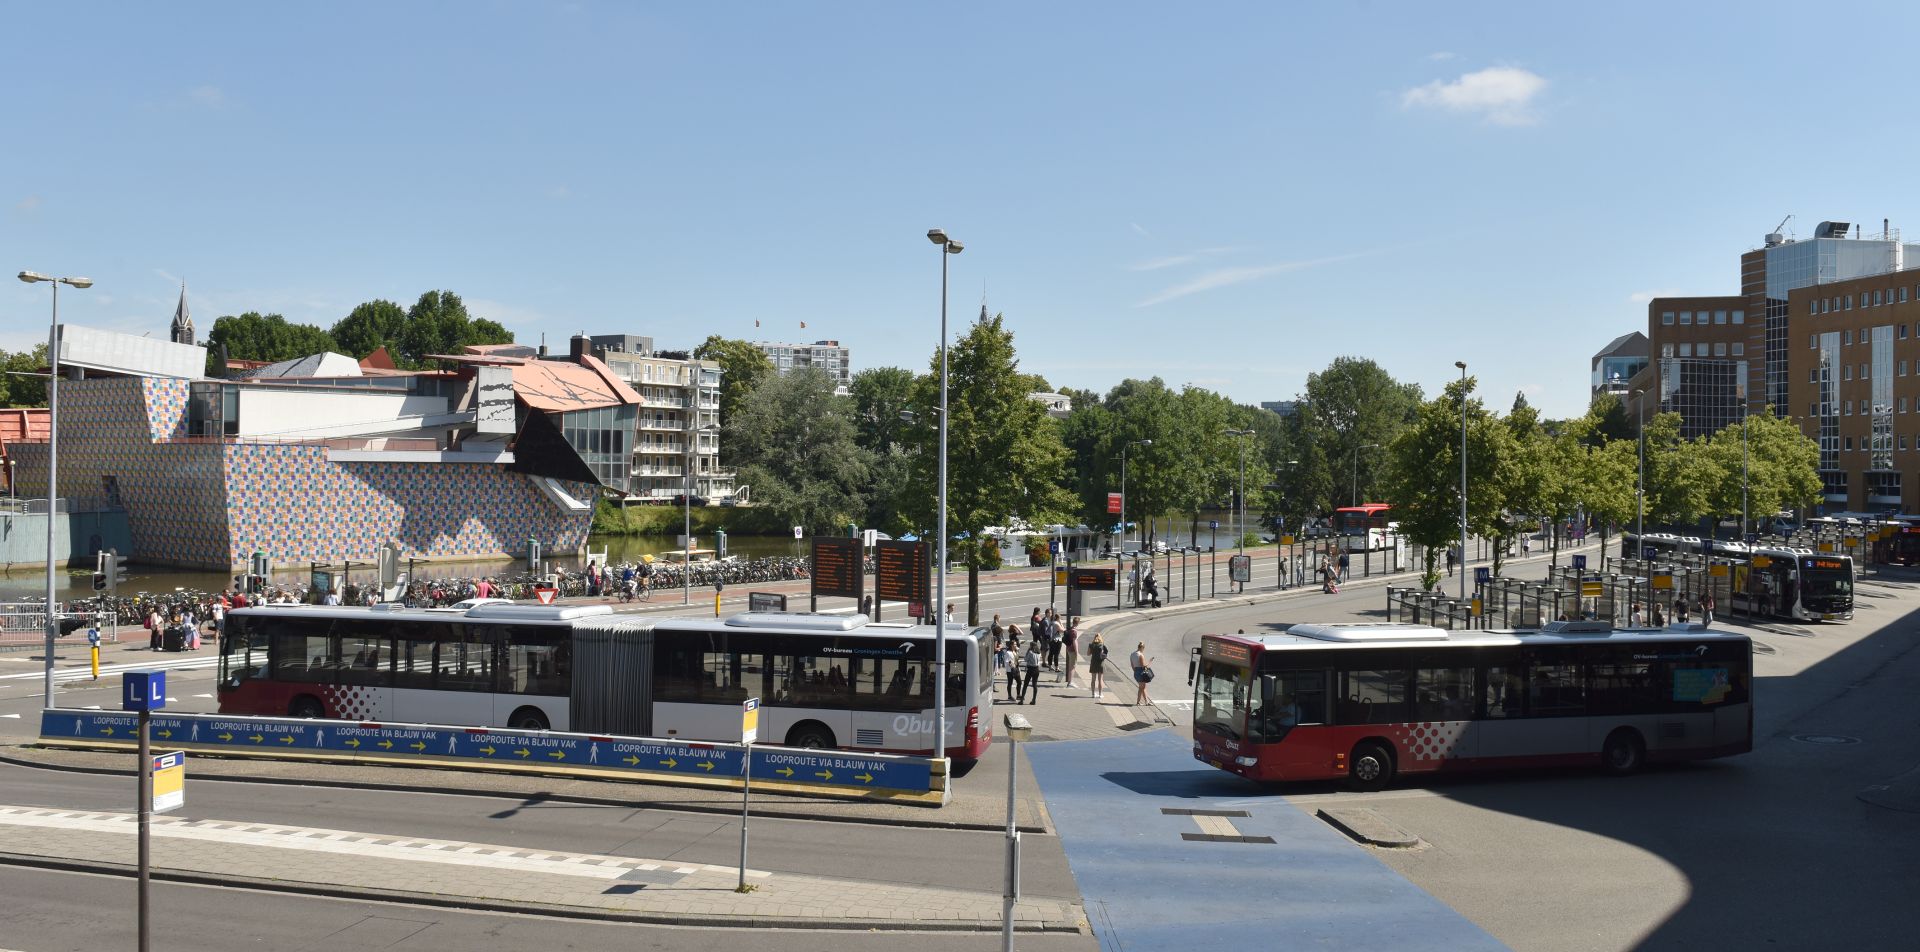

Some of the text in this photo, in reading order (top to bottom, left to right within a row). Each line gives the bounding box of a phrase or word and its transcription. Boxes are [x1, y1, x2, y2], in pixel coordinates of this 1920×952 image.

[1479, 570, 1488, 579] M
[130, 682, 142, 702] L
[152, 682, 162, 701] L
[93, 717, 131, 726] LOOPROUTE
[168, 720, 181, 728] VAK
[210, 722, 304, 734] LOOPROUTE VIA BLAUW VAK
[892, 714, 954, 736] Qbuz
[336, 727, 437, 740] LOOPROUTE VIA BLAUW VAK
[470, 734, 577, 749] LOOPROUTE VIA BLAUW VAK
[613, 743, 727, 760] LOOPROUTE VIA BLAUW VAK
[765, 754, 886, 772] LOOPROUTE VIA BLAUW VAK
